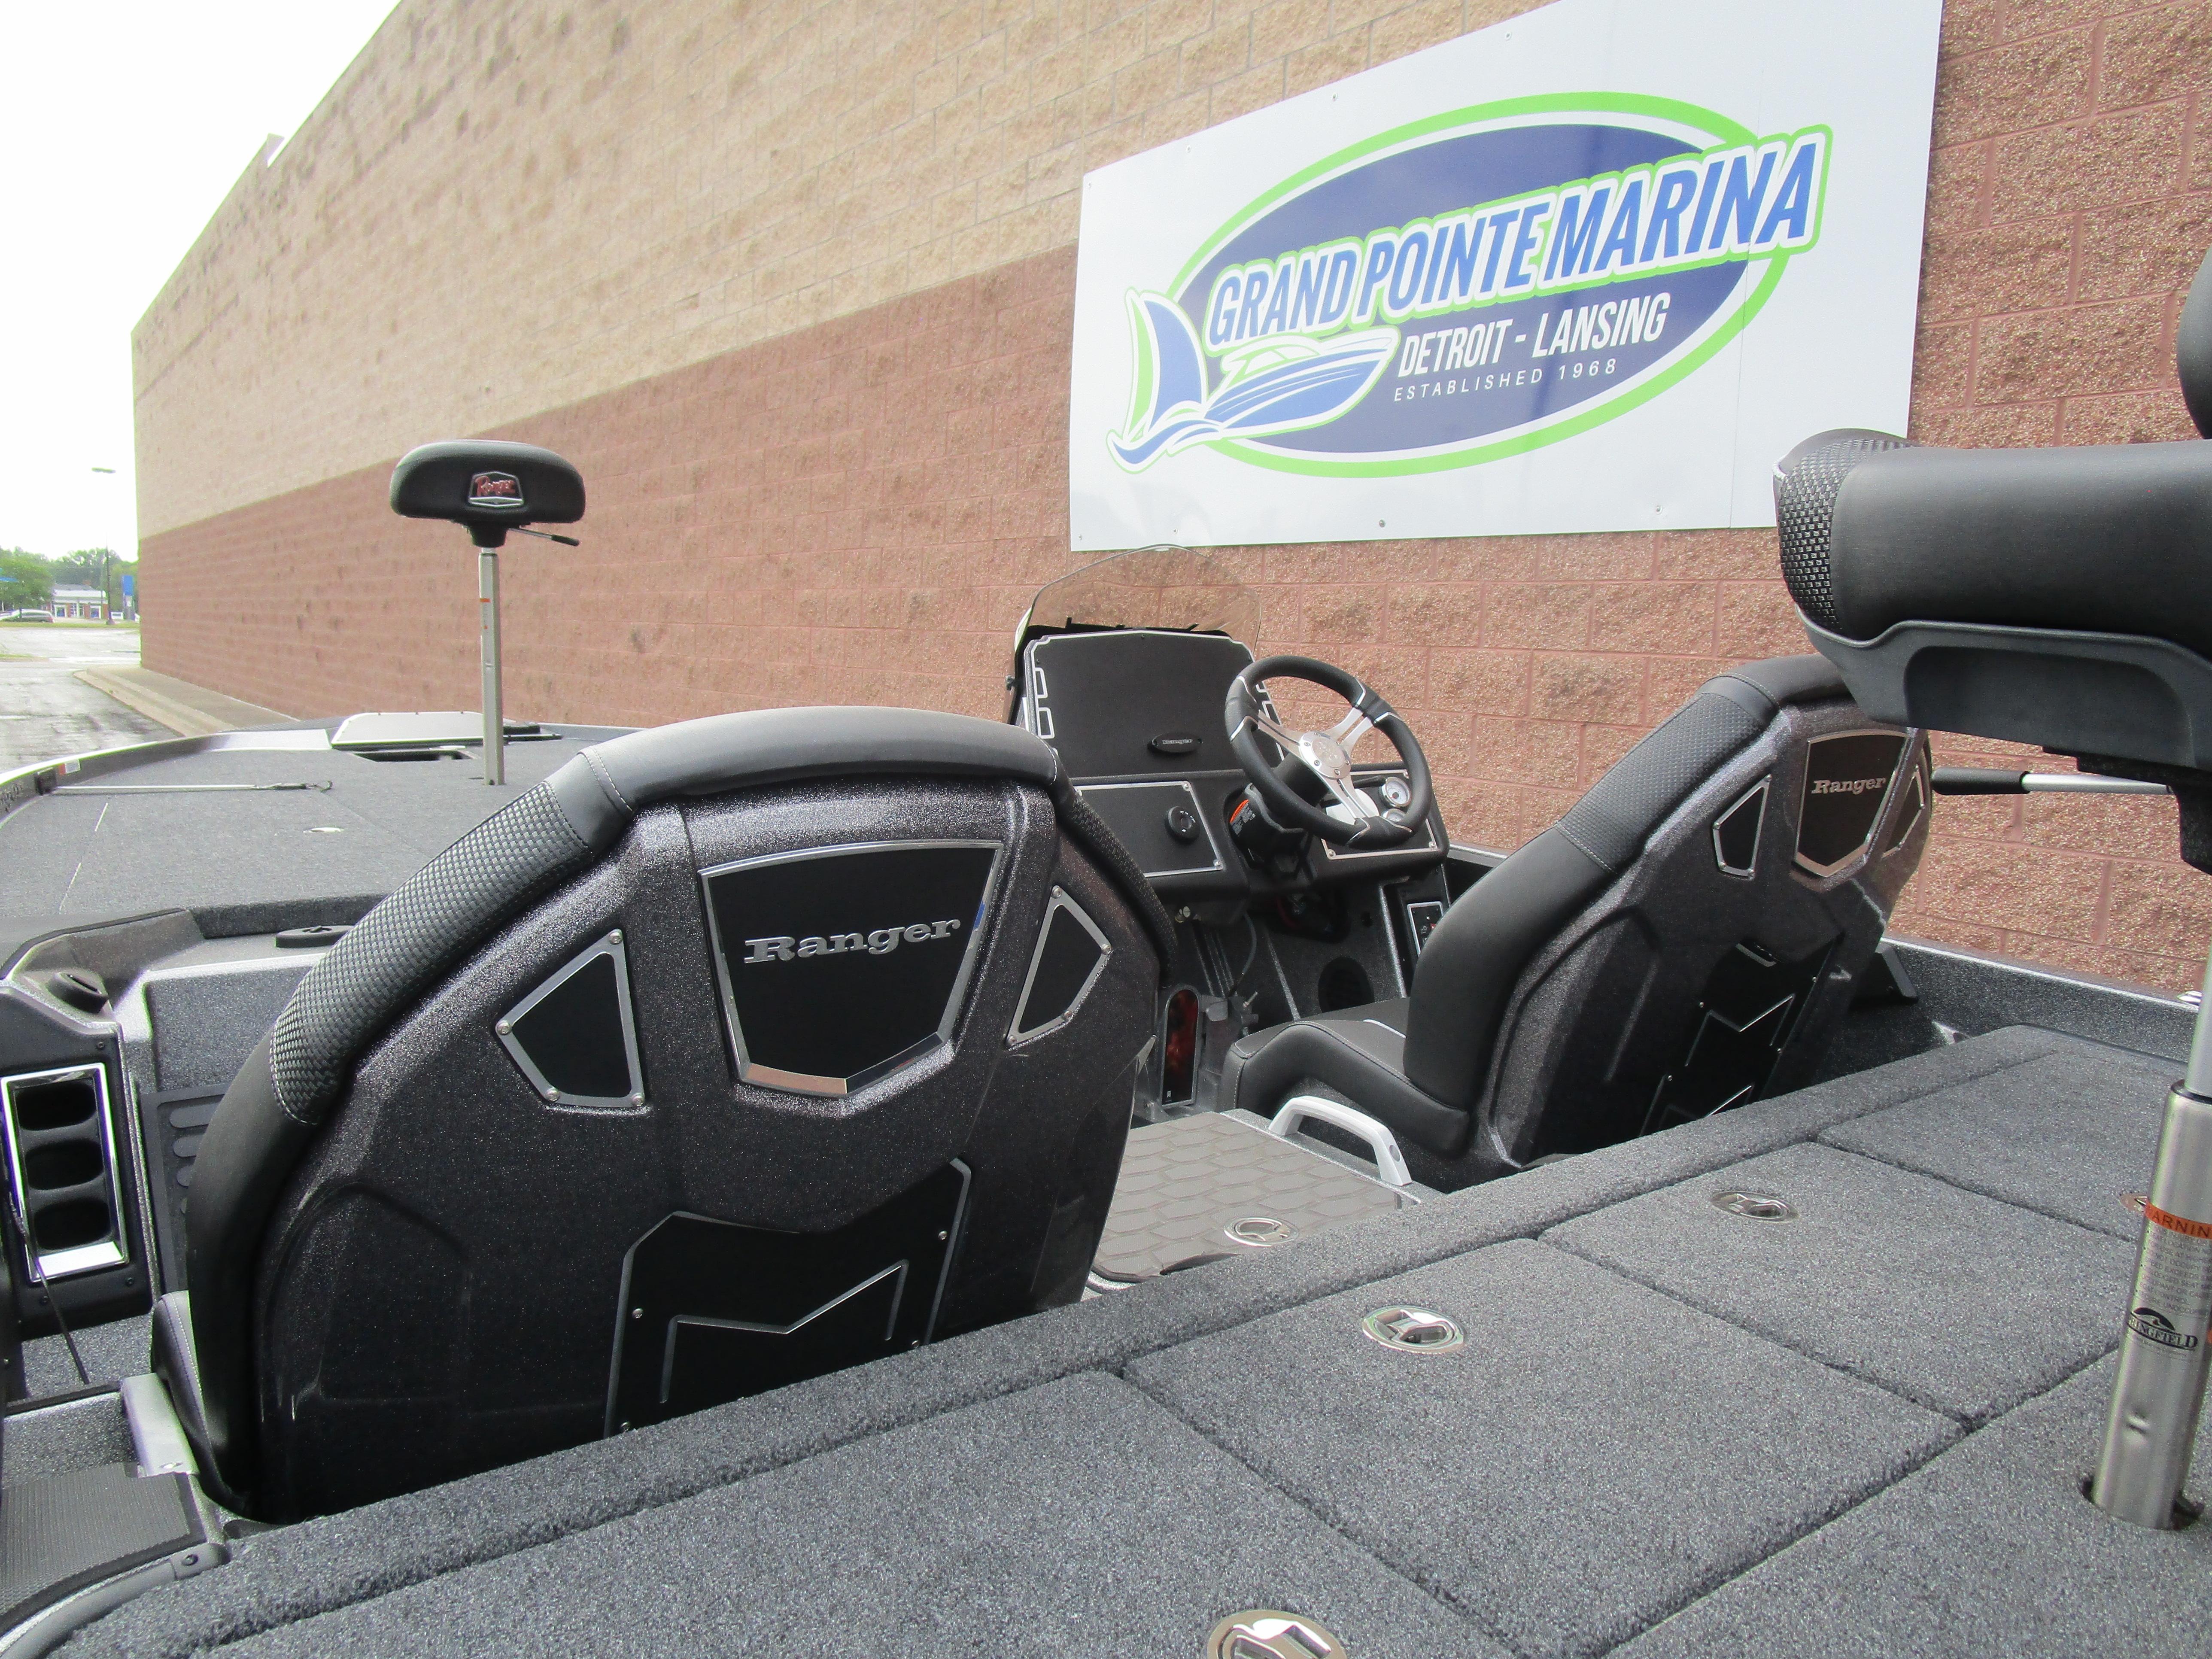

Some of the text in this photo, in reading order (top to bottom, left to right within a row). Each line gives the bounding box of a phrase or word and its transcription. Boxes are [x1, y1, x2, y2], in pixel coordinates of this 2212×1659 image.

[1209, 143, 1816, 345] GRAND POINTE MARINA
[1398, 319, 1513, 377] DETROIT
[1532, 292, 1670, 357] LANSING
[1394, 358, 1616, 401] ESTABLISHED 1968
[1811, 778, 1886, 795] Ranger
[744, 919, 961, 963] Ranger
[2148, 1206, 2210, 1237] ARNIN
